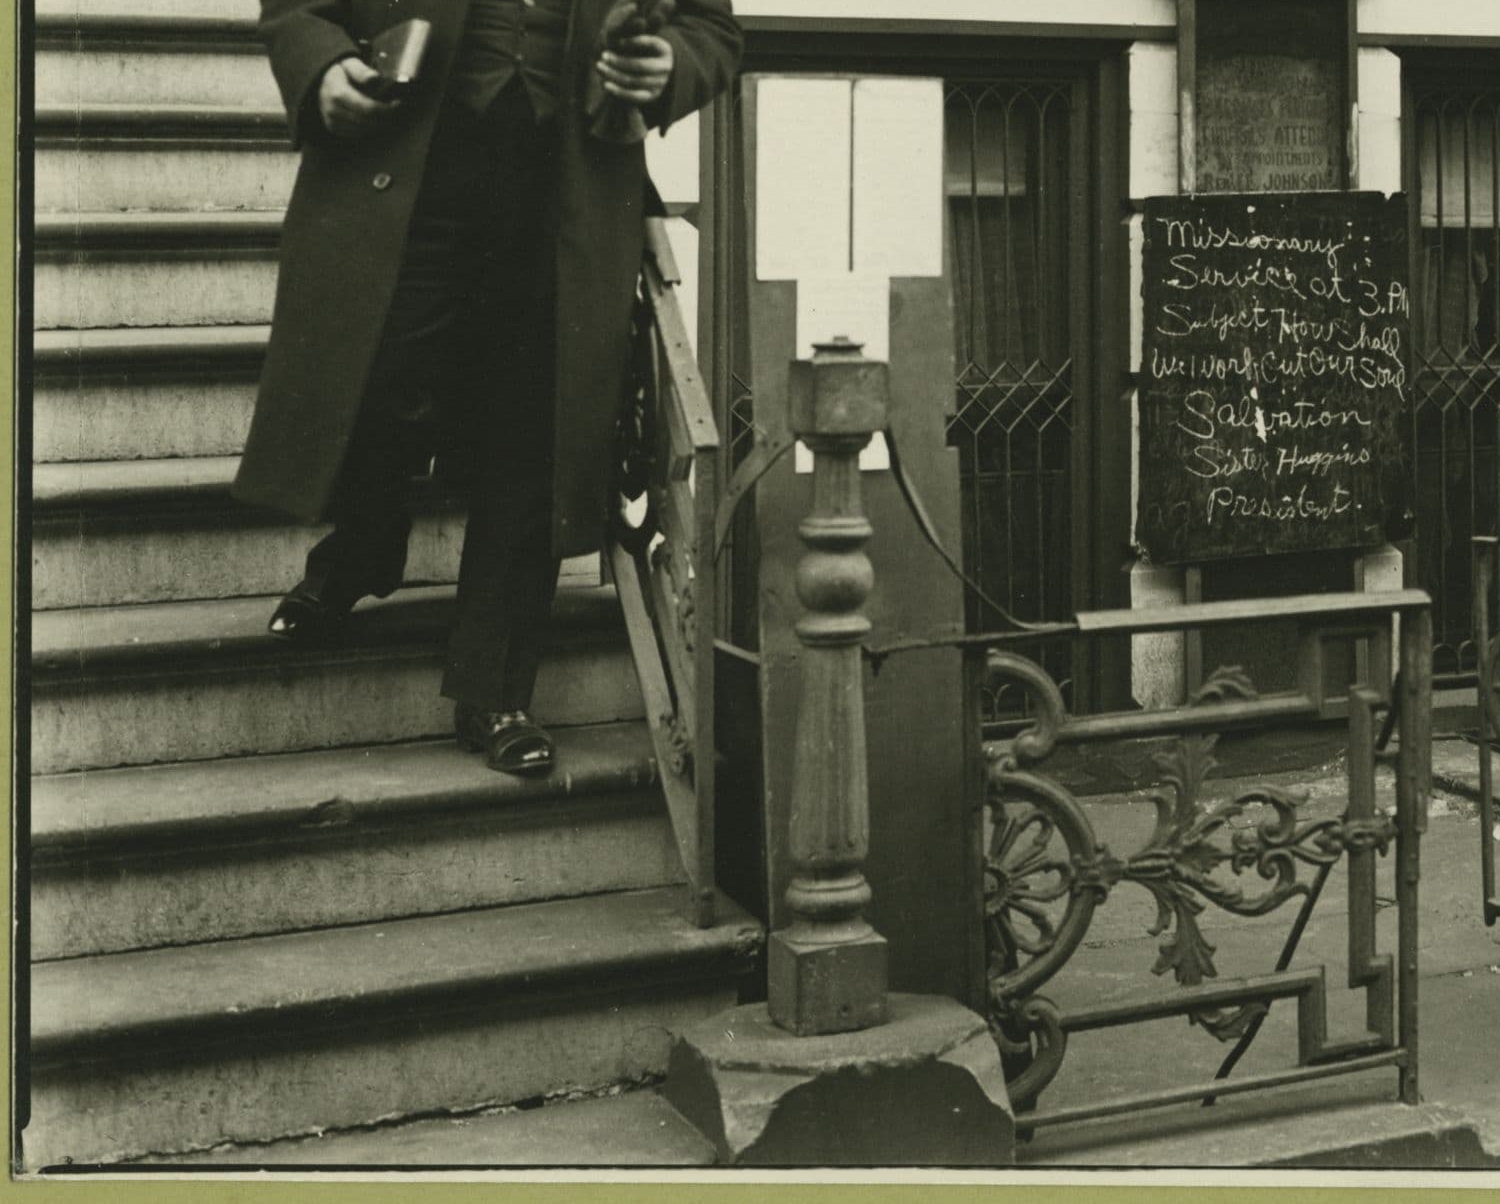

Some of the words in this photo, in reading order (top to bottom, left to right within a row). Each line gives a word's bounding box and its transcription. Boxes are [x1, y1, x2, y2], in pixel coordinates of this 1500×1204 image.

[1156, 217, 1345, 269] Missionary
[1164, 253, 1307, 300] Service
[1310, 272, 1351, 303] at
[1156, 301, 1269, 342] Subject
[1270, 308, 1335, 344] How
[1152, 347, 1186, 380] We
[1308, 346, 1357, 383] Our
[1177, 389, 1371, 440] Salvation
[1184, 445, 1269, 482] Sister
[1276, 443, 1371, 477] Huggins
